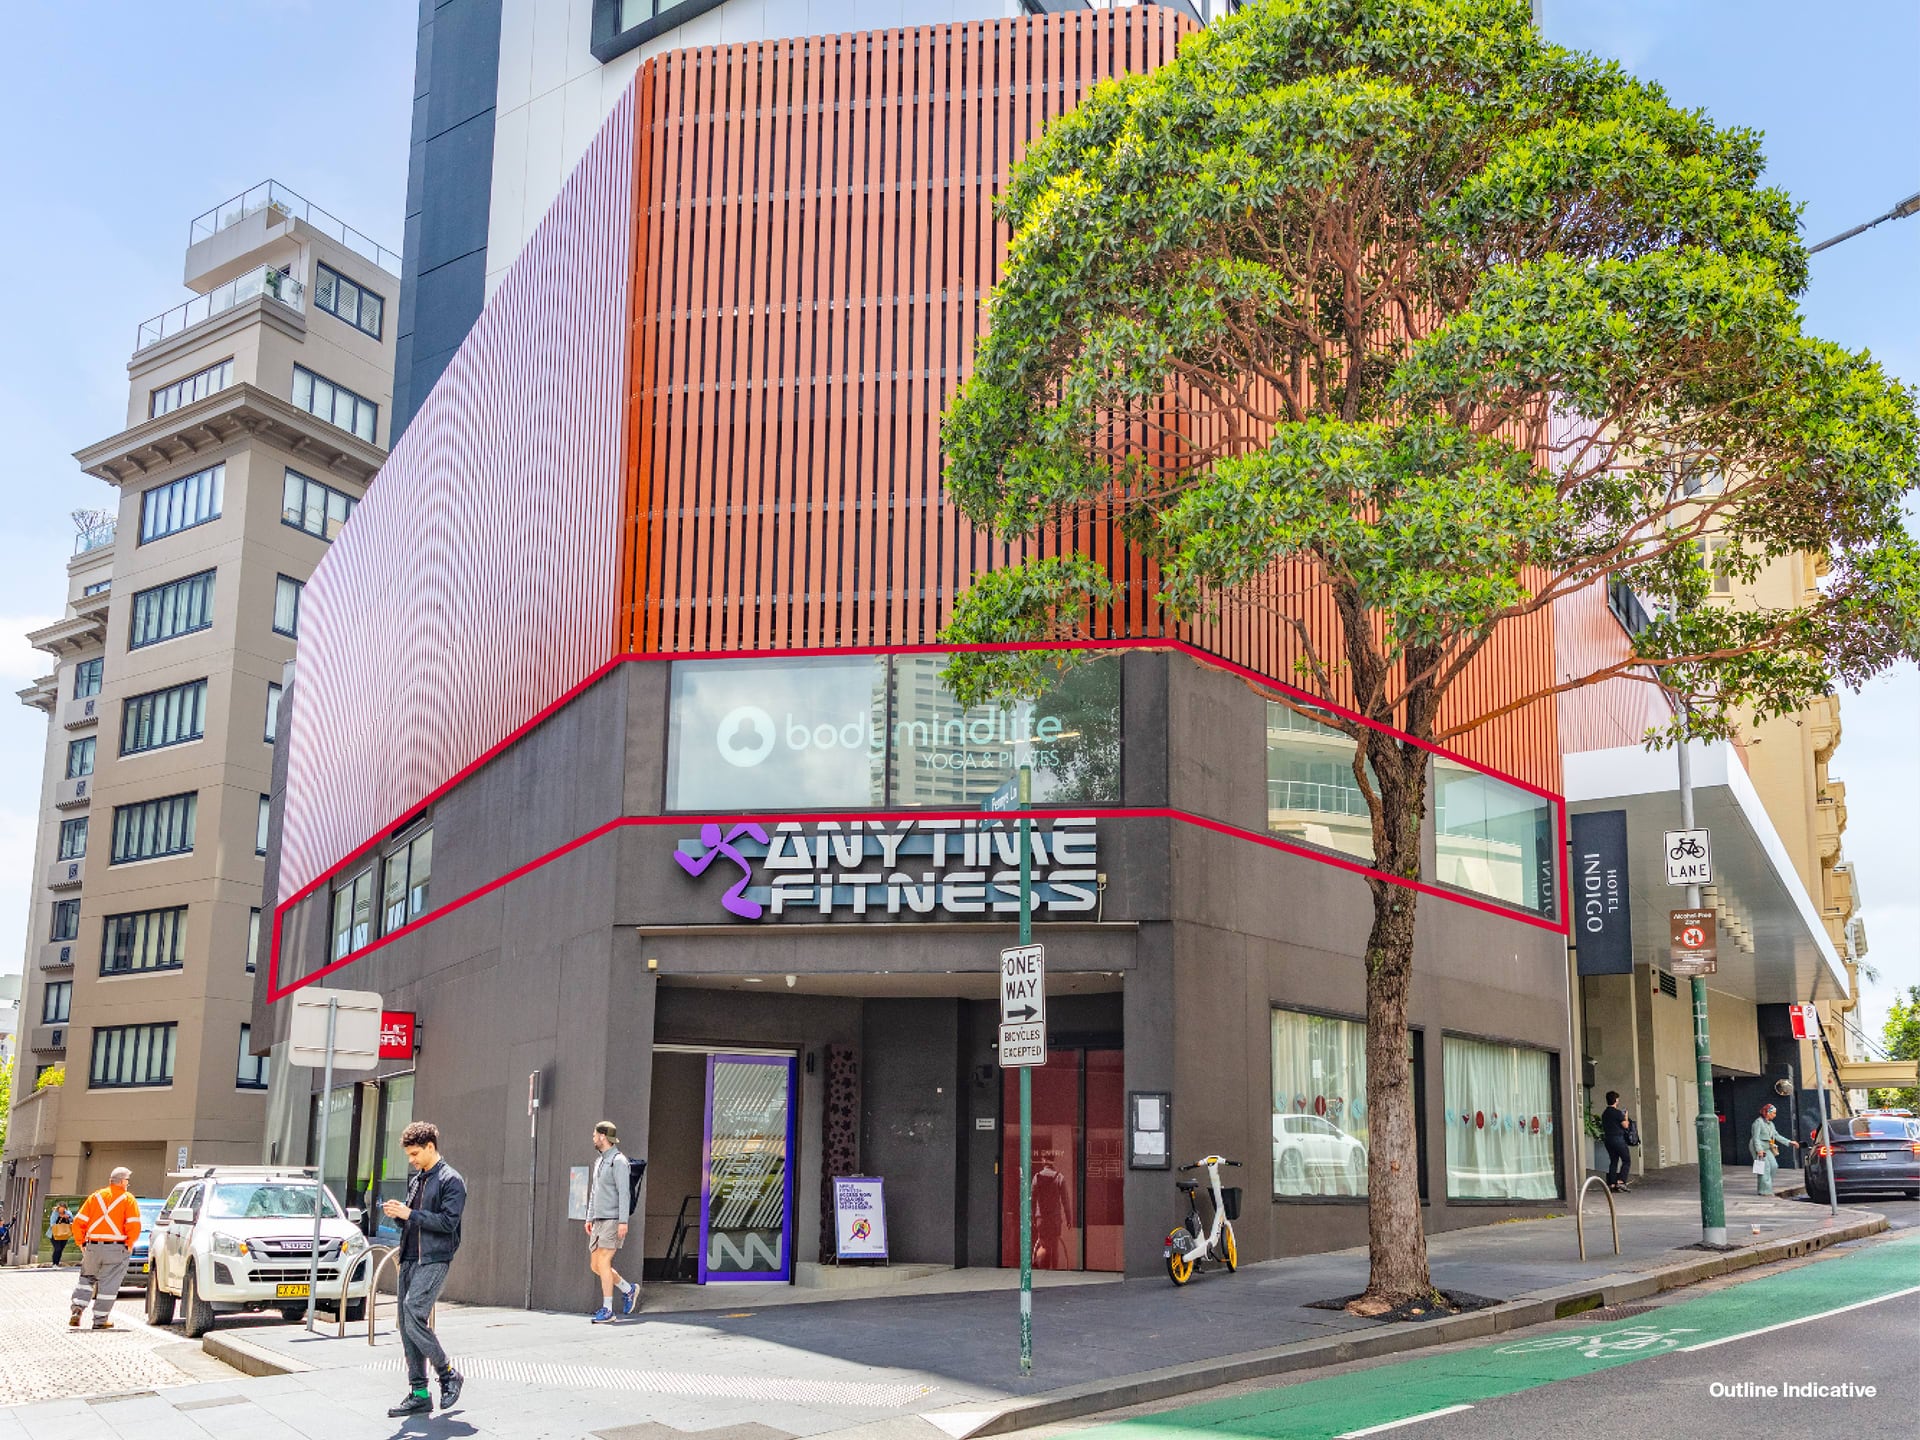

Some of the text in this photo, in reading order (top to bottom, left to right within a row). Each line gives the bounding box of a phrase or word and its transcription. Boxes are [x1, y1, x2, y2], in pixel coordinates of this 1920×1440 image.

[922, 749, 1060, 771] YOGA & PILATES
[763, 817, 1097, 870] ANYTIME
[1670, 863, 1708, 878] LANE
[770, 870, 1097, 915] FITNESS
[1583, 853, 1604, 933] INDIGO
[1607, 869, 1619, 914] HOTEL
[1007, 954, 1036, 976] ONE
[1005, 978, 1038, 1001] WAY
[1004, 1029, 1041, 1042] BICYCLES
[1003, 1045, 1042, 1058] EXCEPTED
